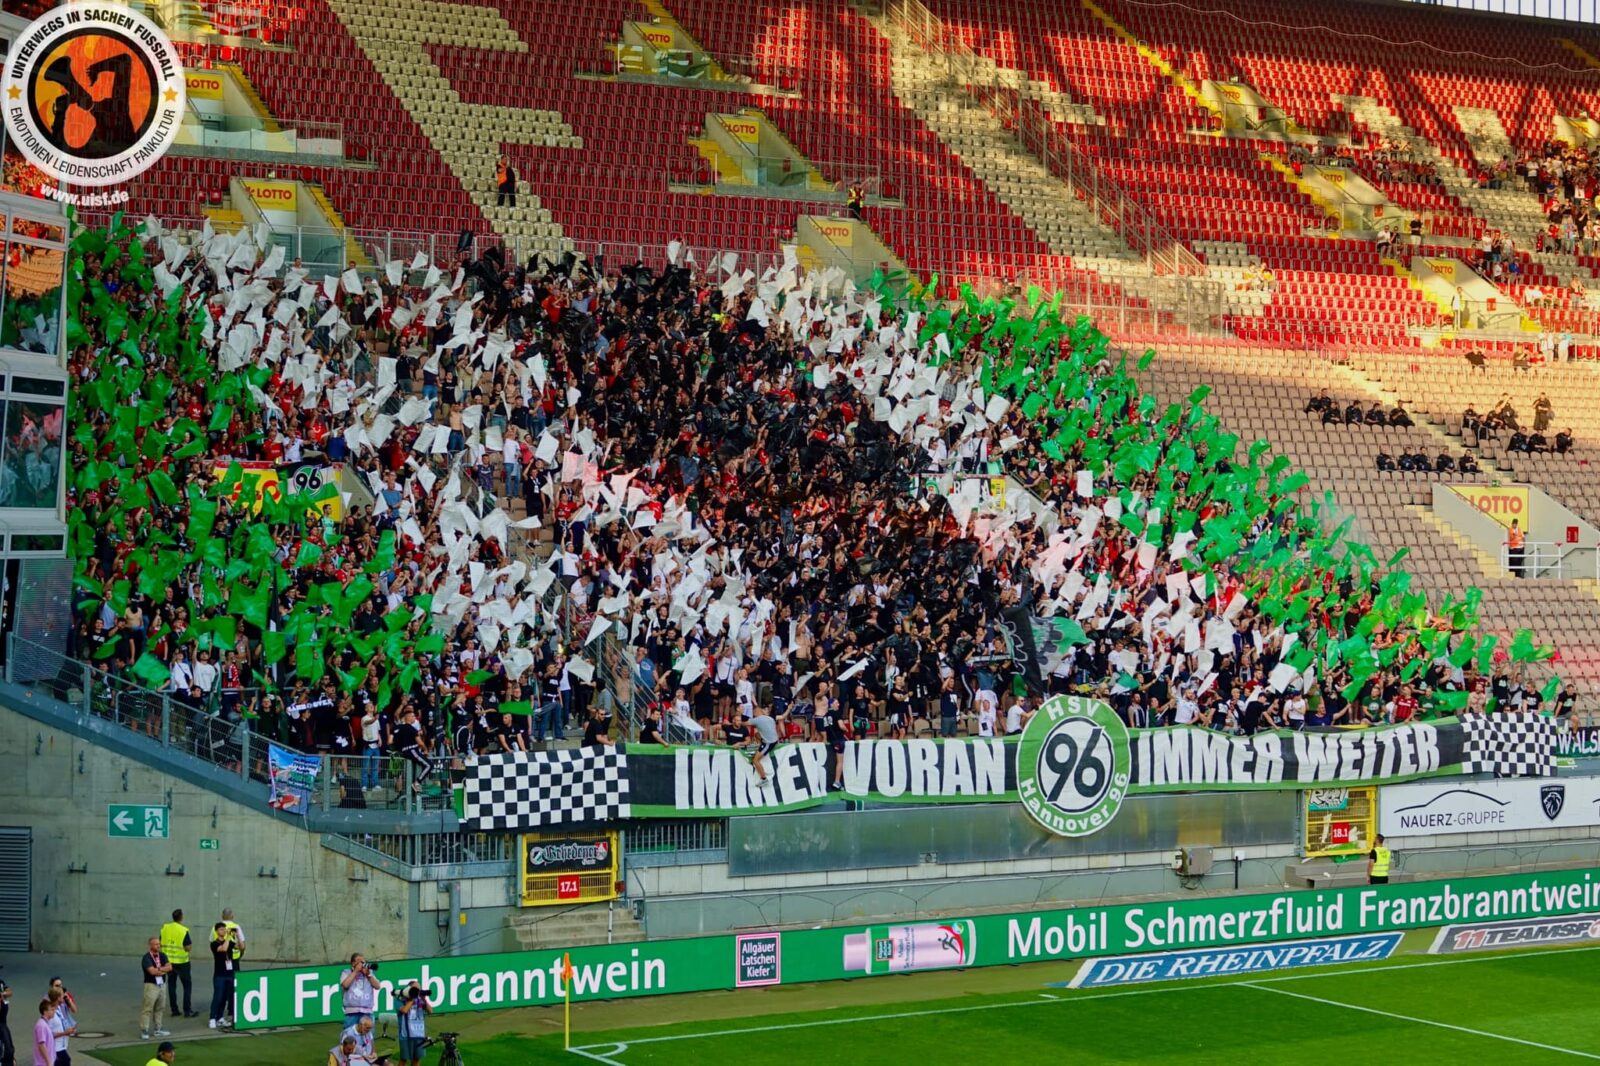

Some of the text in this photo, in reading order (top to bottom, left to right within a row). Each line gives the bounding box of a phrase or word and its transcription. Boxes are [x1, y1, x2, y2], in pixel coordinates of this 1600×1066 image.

[186, 79, 220, 90] LOTTO
[728, 123, 756, 134] LOTTO
[257, 189, 292, 200] LOTTO
[823, 226, 849, 237] LOTTO
[294, 466, 322, 490] 96
[1470, 496, 1523, 514] LOTTO
[1046, 696, 1100, 721] HSV
[1558, 729, 1600, 754] WALS
[1045, 727, 1106, 804] 96
[1137, 723, 1440, 786] IMMER WEITER
[674, 738, 1006, 810] IMMER VORAN
[1020, 772, 1128, 832] Hannover 96
[1400, 810, 1505, 828] NAUERZ-GRUPPE
[1333, 828, 1348, 838] 18.1
[1008, 911, 1107, 958] Mobil
[1124, 893, 1344, 948] Schmerzfluid
[741, 941, 776, 955] Allgäuer
[741, 953, 776, 966] Latschen
[1093, 939, 1389, 984] DIE RHEINPFALZ
[294, 948, 666, 1019] Frnbranntwein
